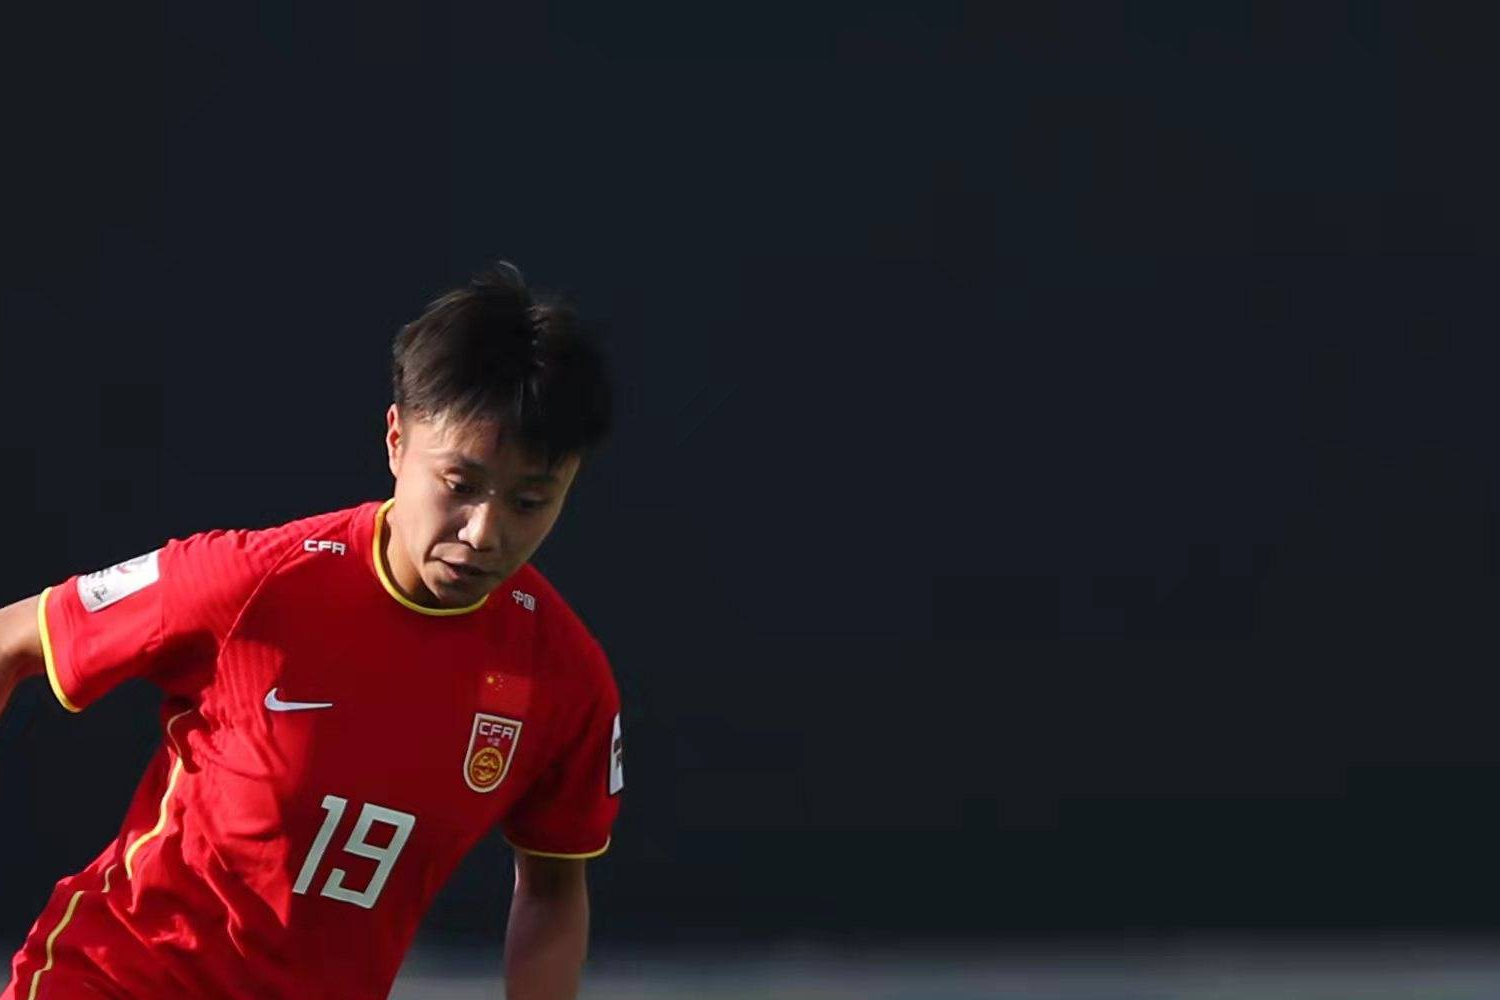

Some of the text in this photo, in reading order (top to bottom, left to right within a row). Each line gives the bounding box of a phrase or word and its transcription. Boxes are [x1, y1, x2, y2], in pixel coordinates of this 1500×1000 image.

[303, 539, 346, 556] CFA
[478, 721, 514, 740] CFA
[292, 794, 416, 909] 19
